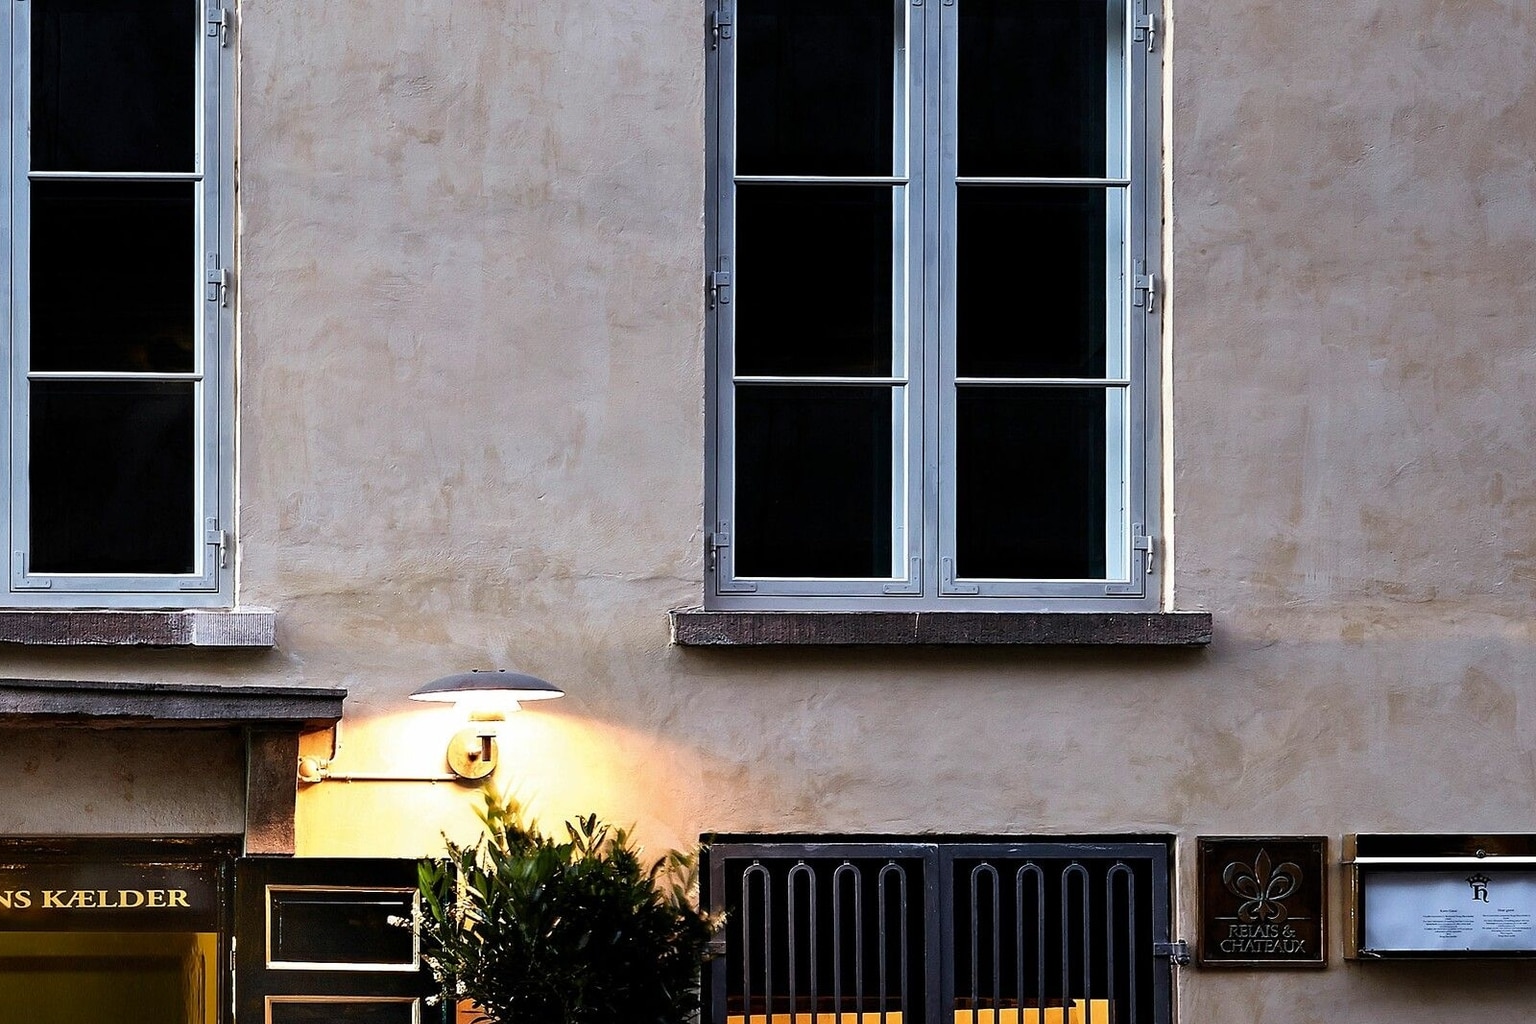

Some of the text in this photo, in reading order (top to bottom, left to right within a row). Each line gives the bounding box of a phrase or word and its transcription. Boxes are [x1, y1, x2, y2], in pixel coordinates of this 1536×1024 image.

[41, 889, 190, 908] KÆLDER
[1228, 924, 1296, 938] RELAIS &
[1220, 939, 1306, 953] CHATEAUX
